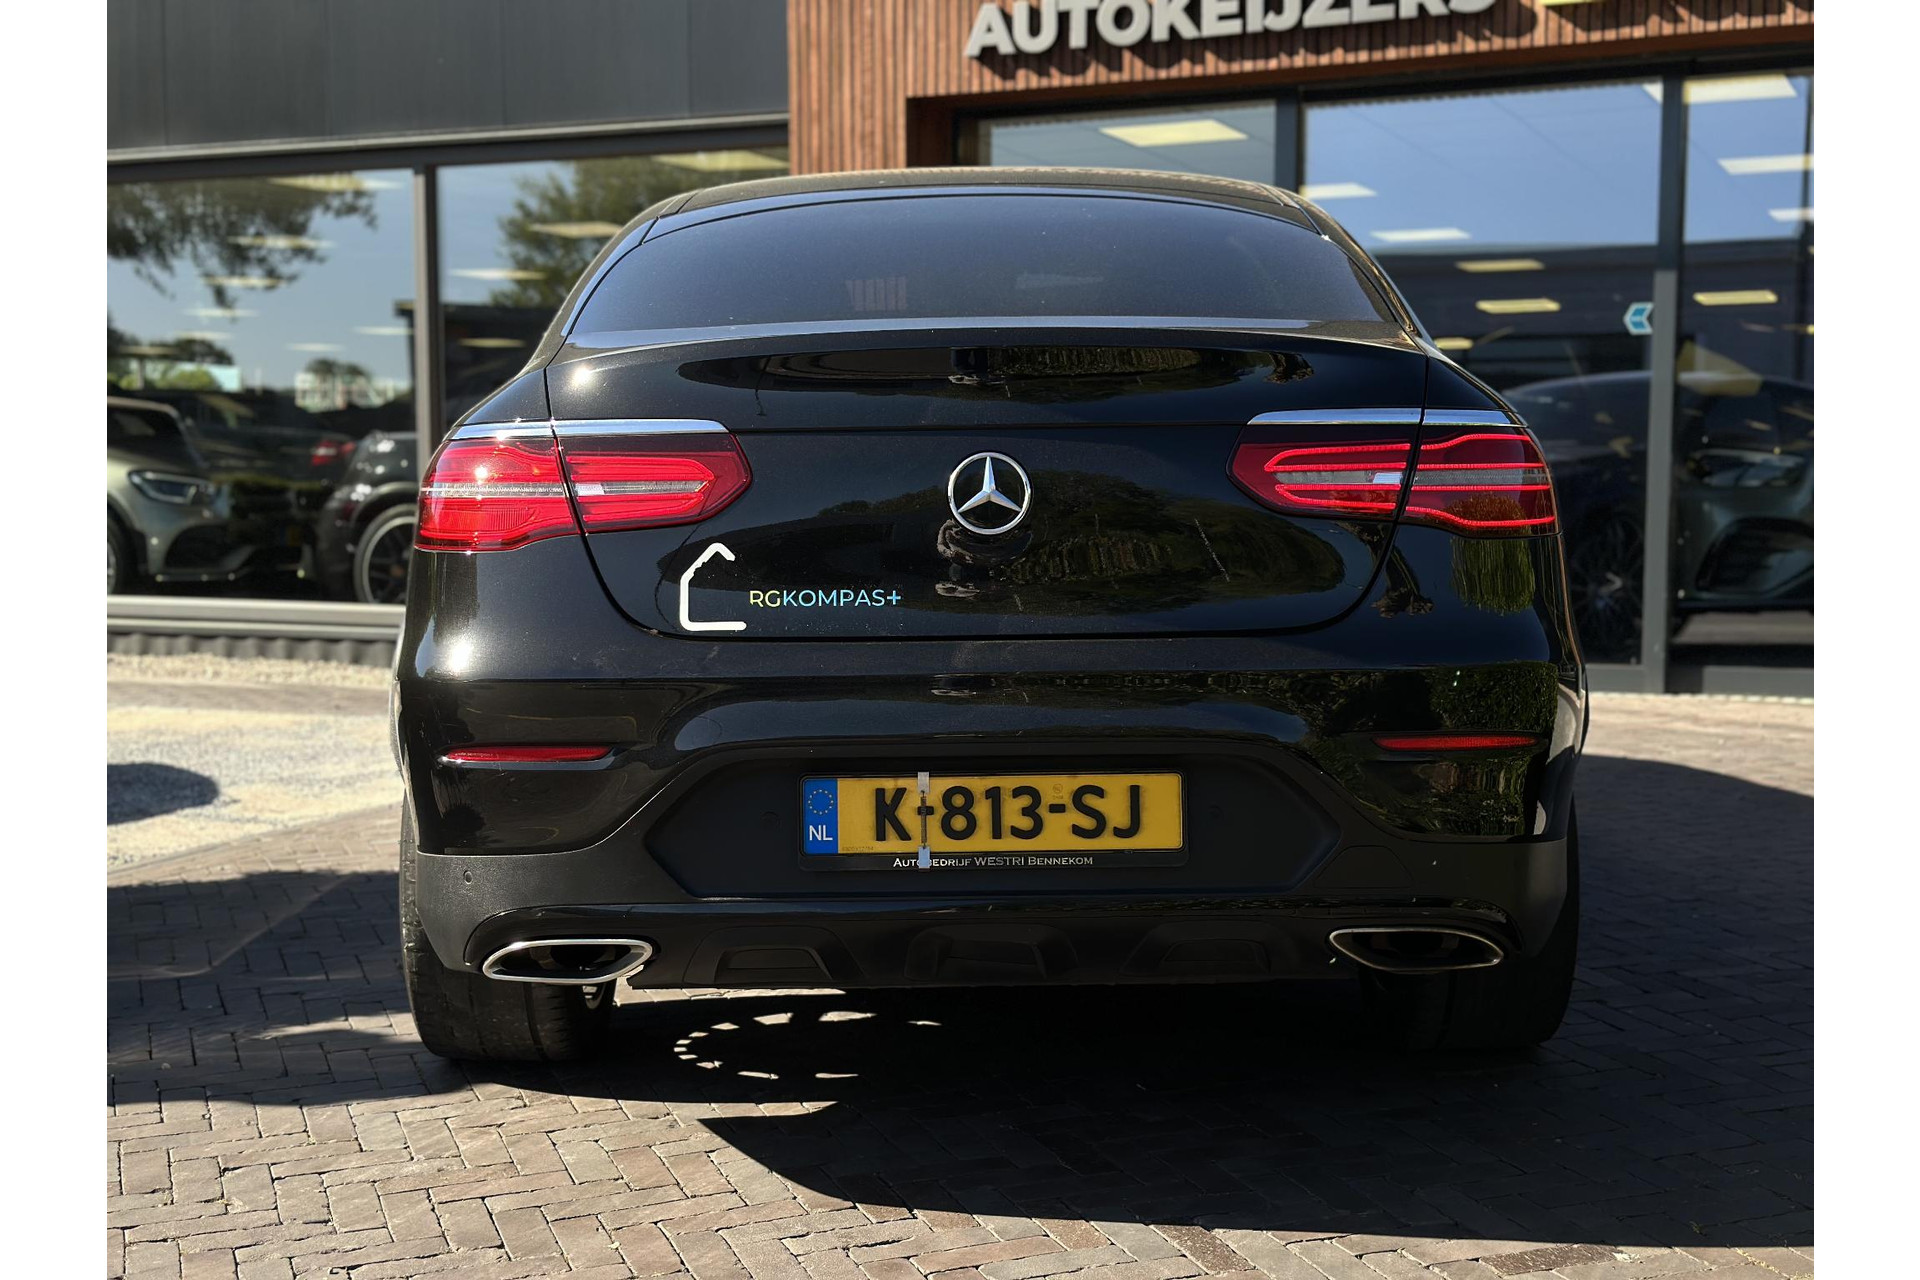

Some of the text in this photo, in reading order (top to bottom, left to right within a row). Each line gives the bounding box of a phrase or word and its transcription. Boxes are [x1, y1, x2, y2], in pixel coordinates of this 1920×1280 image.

[966, 0, 1496, 57] AUTOKEIJZ
[875, 784, 1141, 842] K-813-SJ
[809, 824, 833, 841] NL
[893, 856, 1093, 868] AUTEDRIJF WESTRI BENNEKOM
